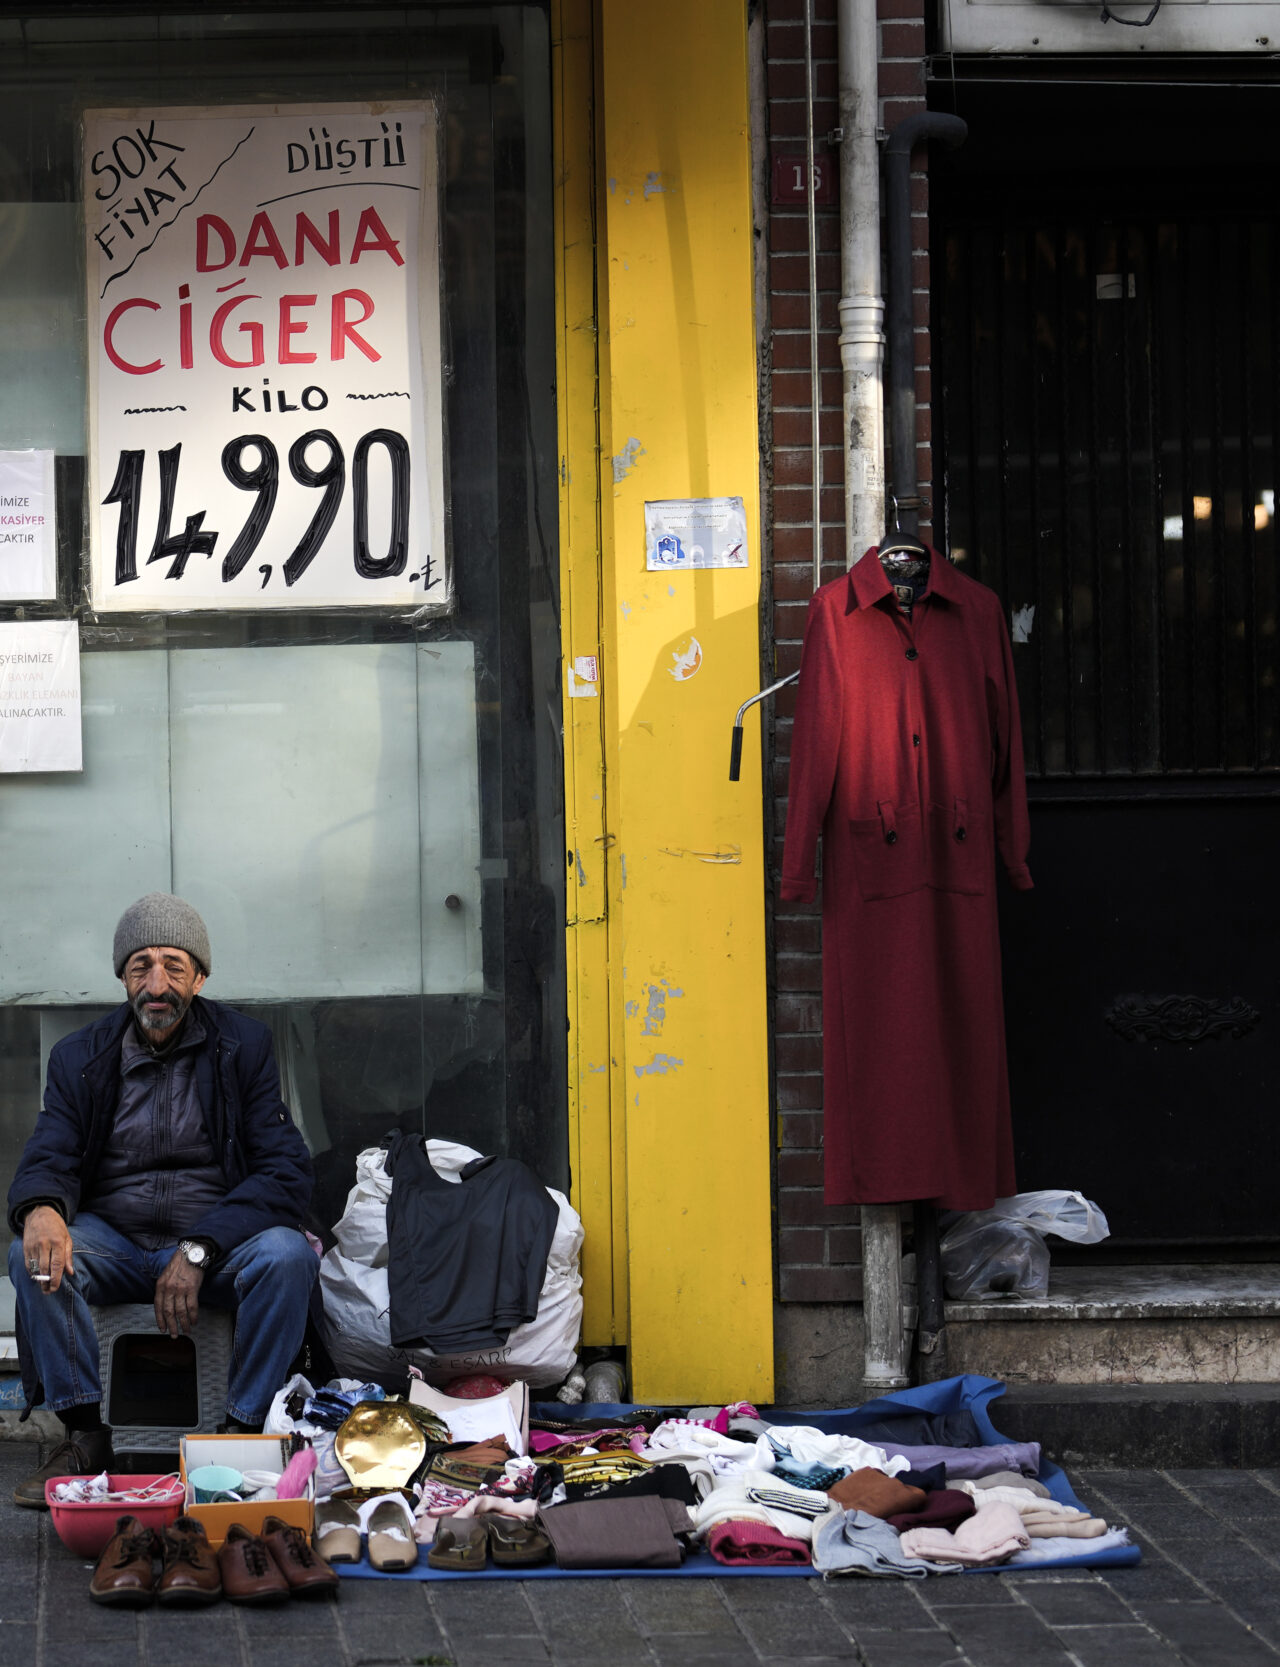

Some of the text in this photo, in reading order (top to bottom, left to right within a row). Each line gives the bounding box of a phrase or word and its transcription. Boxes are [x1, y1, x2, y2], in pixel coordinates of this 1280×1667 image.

[287, 121, 407, 175] DÜŞTÜ
[94, 157, 187, 260] FİYAT
[197, 206, 406, 273] DANA
[104, 278, 382, 374] CİĞER
[232, 379, 329, 413] KİLO
